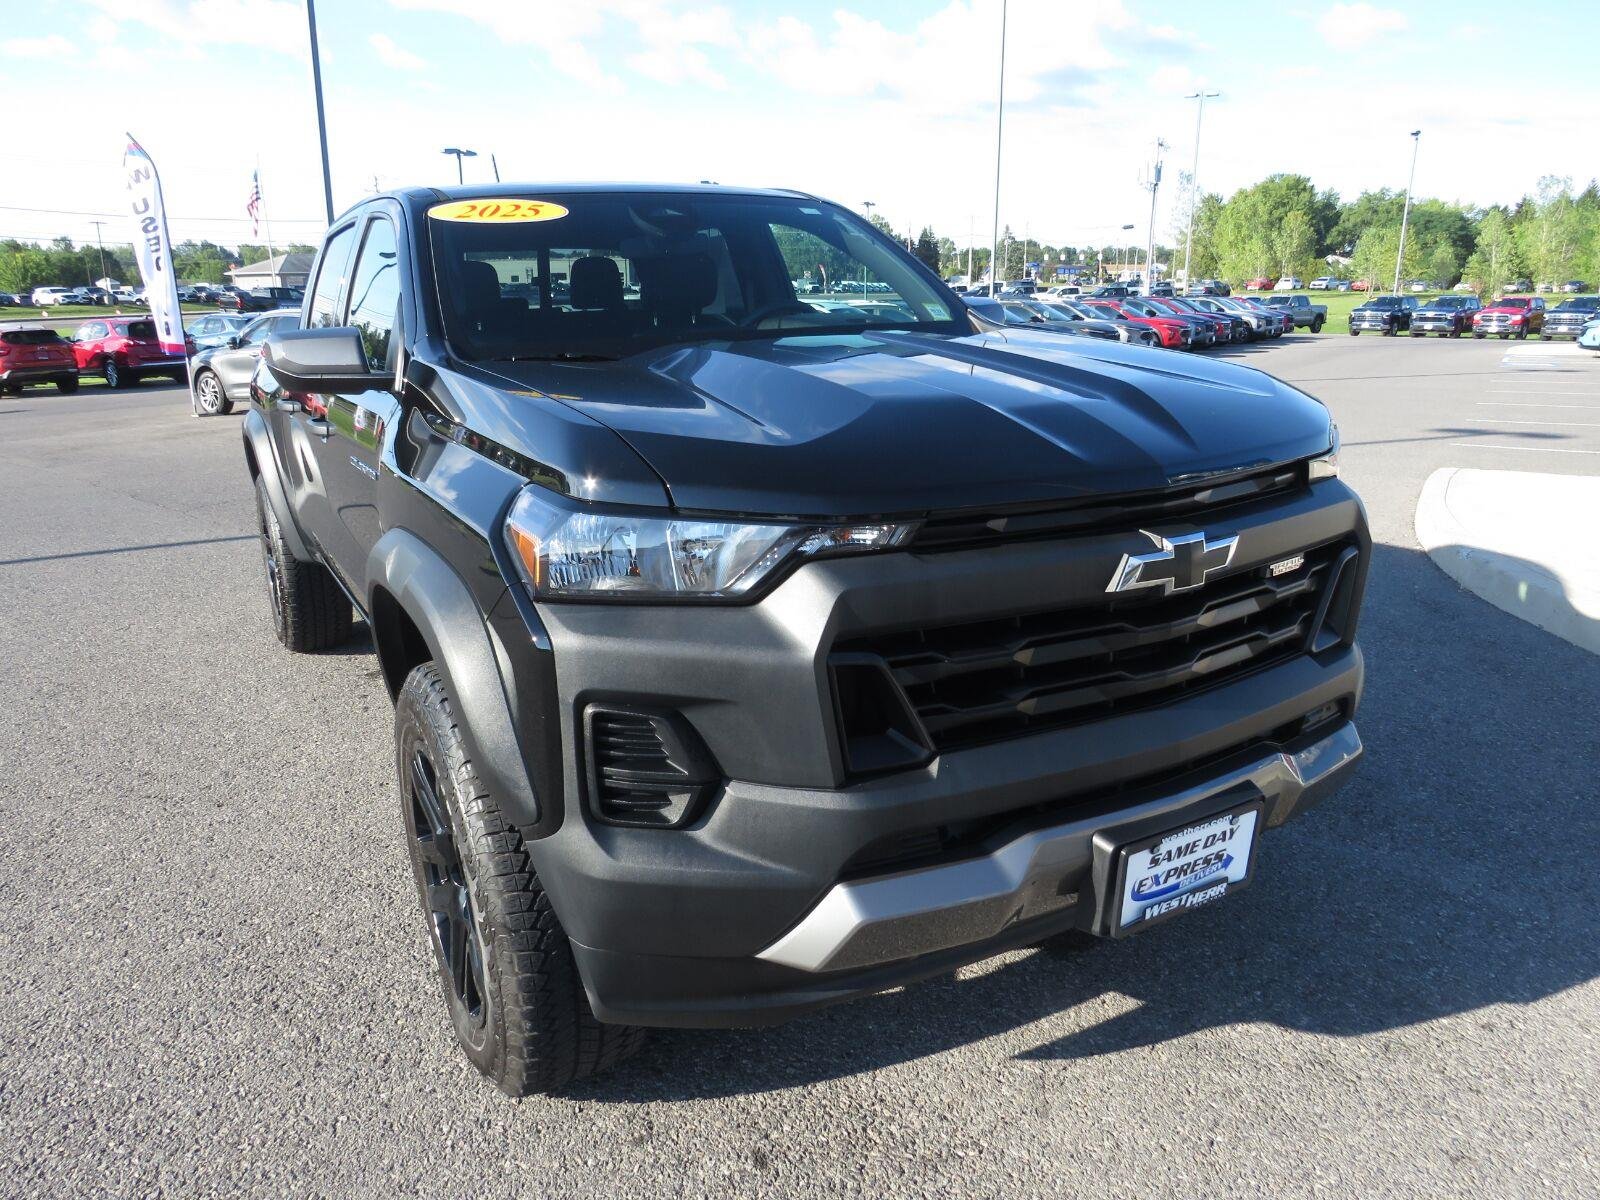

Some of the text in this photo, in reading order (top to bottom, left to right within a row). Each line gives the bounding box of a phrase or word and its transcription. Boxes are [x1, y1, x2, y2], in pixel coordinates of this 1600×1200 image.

[454, 204, 544, 219] 2025
[1161, 814, 1233, 844] westherr.com
[1148, 825, 1240, 869] SAME DAY
[1136, 848, 1227, 894] EXPRESS
[1179, 862, 1223, 888] DELIVERY
